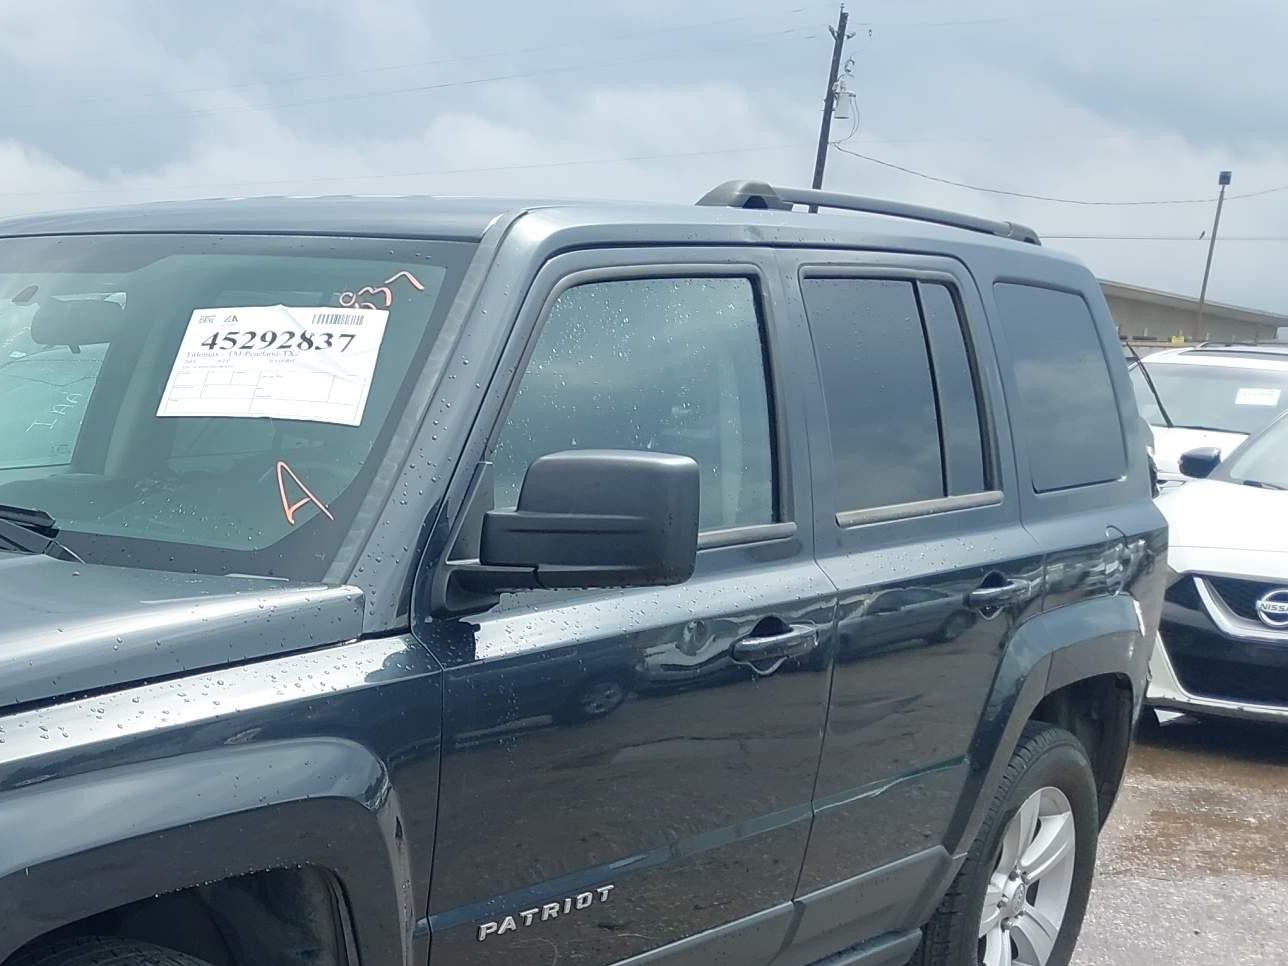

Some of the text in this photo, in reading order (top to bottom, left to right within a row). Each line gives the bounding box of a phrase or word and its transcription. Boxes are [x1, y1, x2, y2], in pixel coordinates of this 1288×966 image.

[201, 329, 357, 352] 45292837
[276, 460, 334, 525] A
[478, 884, 615, 941] PATRIOT
